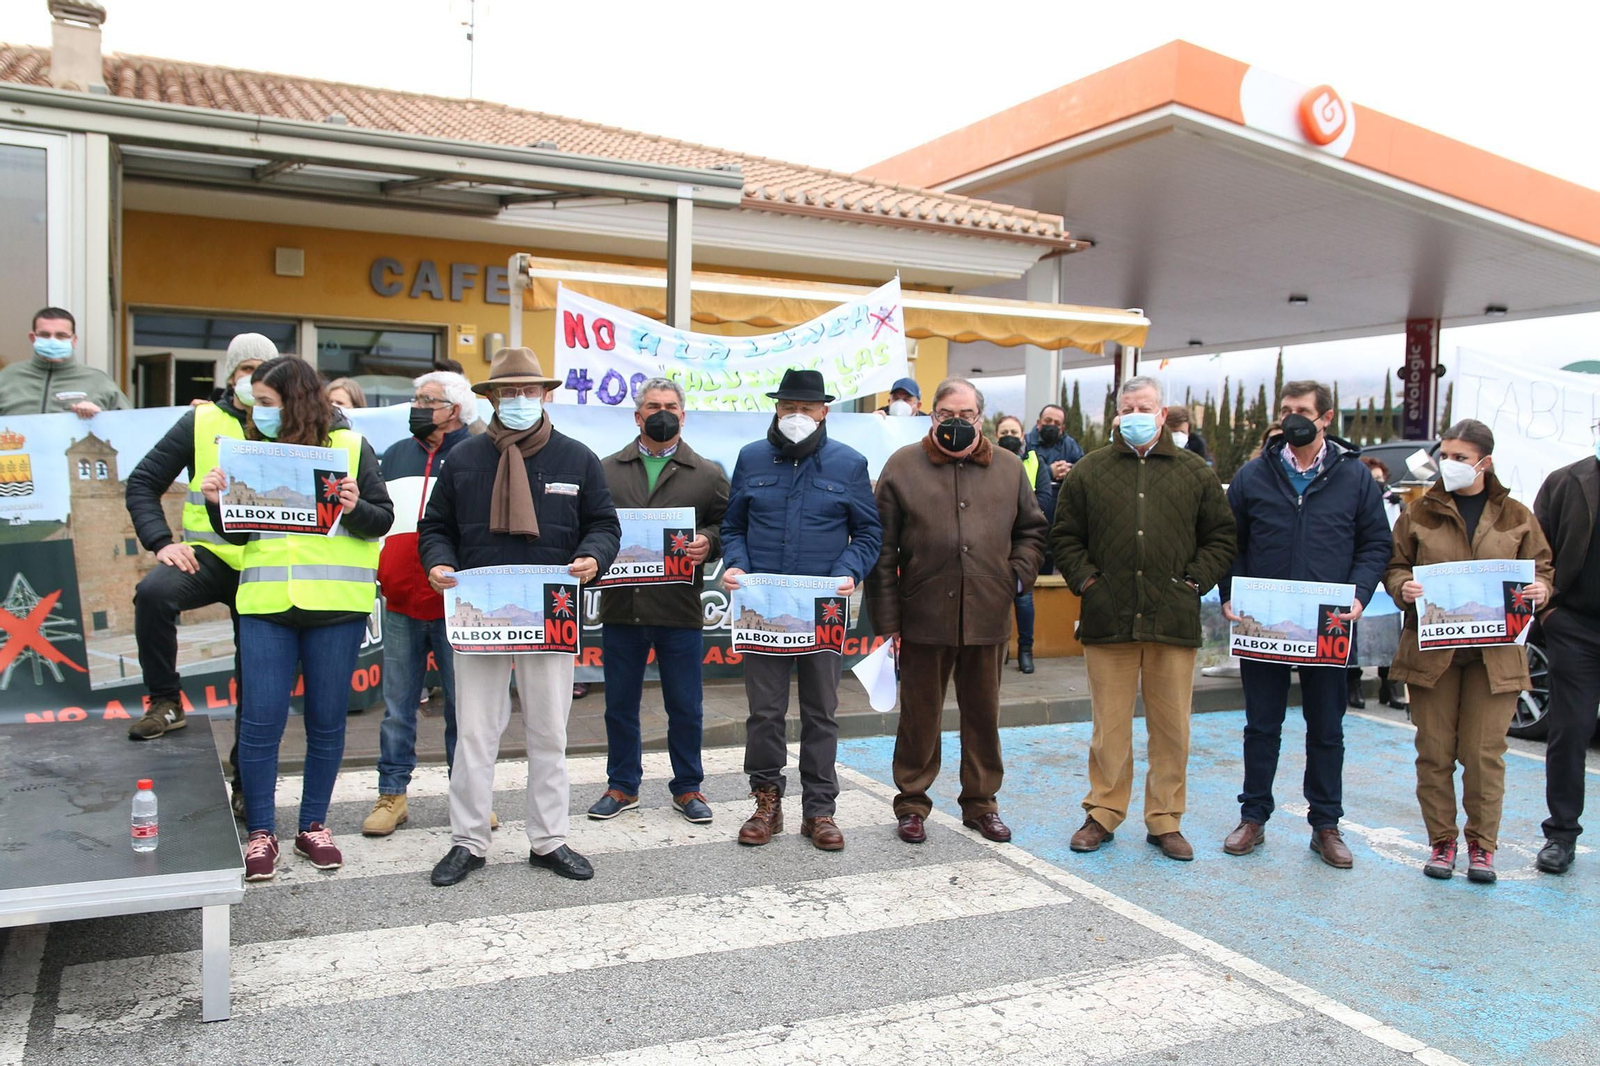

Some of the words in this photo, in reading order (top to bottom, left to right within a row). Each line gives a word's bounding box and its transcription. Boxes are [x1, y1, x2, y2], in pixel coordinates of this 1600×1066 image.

[371, 257, 510, 304] CAFE
[563, 310, 616, 351] NO
[1408, 344, 1425, 420] evologic
[232, 445, 265, 455] SIERRA
[267, 448, 286, 457] DEL
[289, 449, 334, 461] SALIENTE
[225, 510, 276, 520] ALBOX
[282, 511, 316, 522] DICE
[642, 512, 682, 520] SALIENTE
[634, 565, 663, 574] DICE
[665, 556, 692, 576] NO
[1456, 565, 1475, 574] DEL
[1478, 564, 1520, 573] SALIENTE
[742, 578, 773, 586] SIERRA
[775, 579, 791, 587] DEL
[793, 580, 835, 589] SALIENTE
[1245, 582, 1277, 591] SIERRA
[1280, 584, 1295, 593] DEL
[1299, 585, 1341, 596] SALIENTE
[452, 631, 501, 640] ALBOX
[508, 630, 543, 640] DICE
[545, 619, 577, 645] NO
[736, 632, 778, 643] ALBOX
[784, 635, 814, 644] DICE
[816, 625, 844, 645] NO
[1421, 626, 1465, 637] ALBOX
[1472, 624, 1505, 633] DICE
[1234, 638, 1278, 650] ALBOX
[1284, 644, 1315, 653] DICE
[1318, 635, 1349, 659] NO
[103, 700, 131, 720] A
